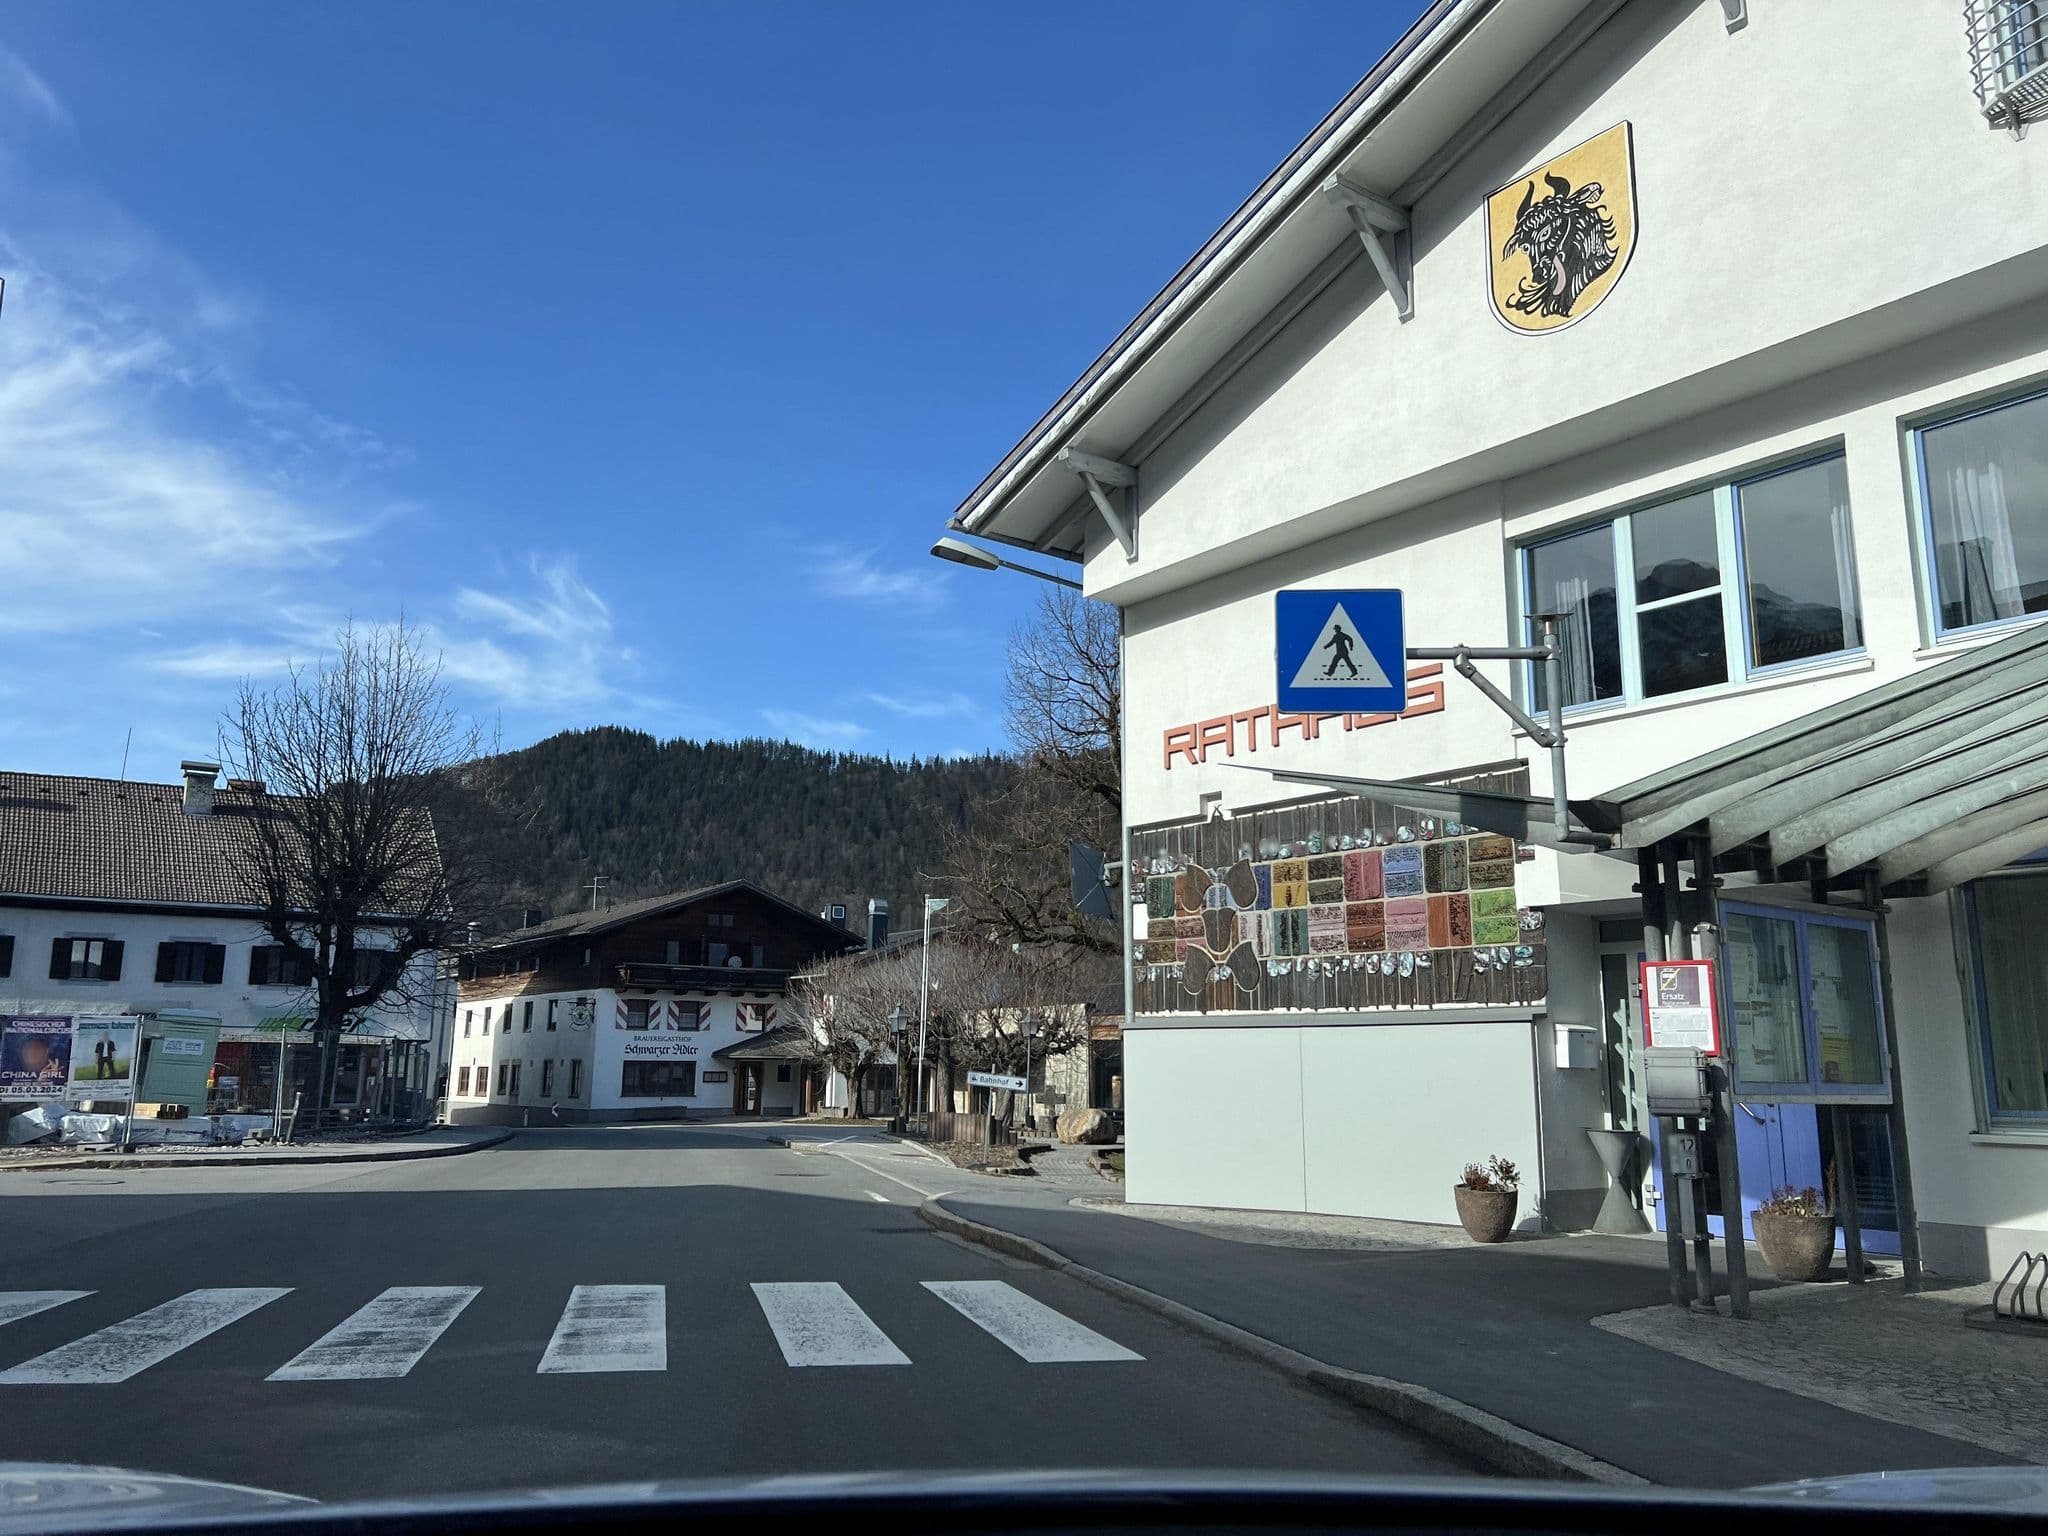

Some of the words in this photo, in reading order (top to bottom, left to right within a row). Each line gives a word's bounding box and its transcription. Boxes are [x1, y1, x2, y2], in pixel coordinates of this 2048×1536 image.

[1661, 992, 1685, 1001] Ersatz
[624, 1043, 671, 1057] Schwarzer
[671, 1043, 699, 1056] Adler
[1, 1071, 37, 1079] CHINA
[39, 1071, 65, 1079] GIRL
[980, 1075, 1009, 1085] Bahnhof
[11, 1086, 63, 1094] 05.03.2024
